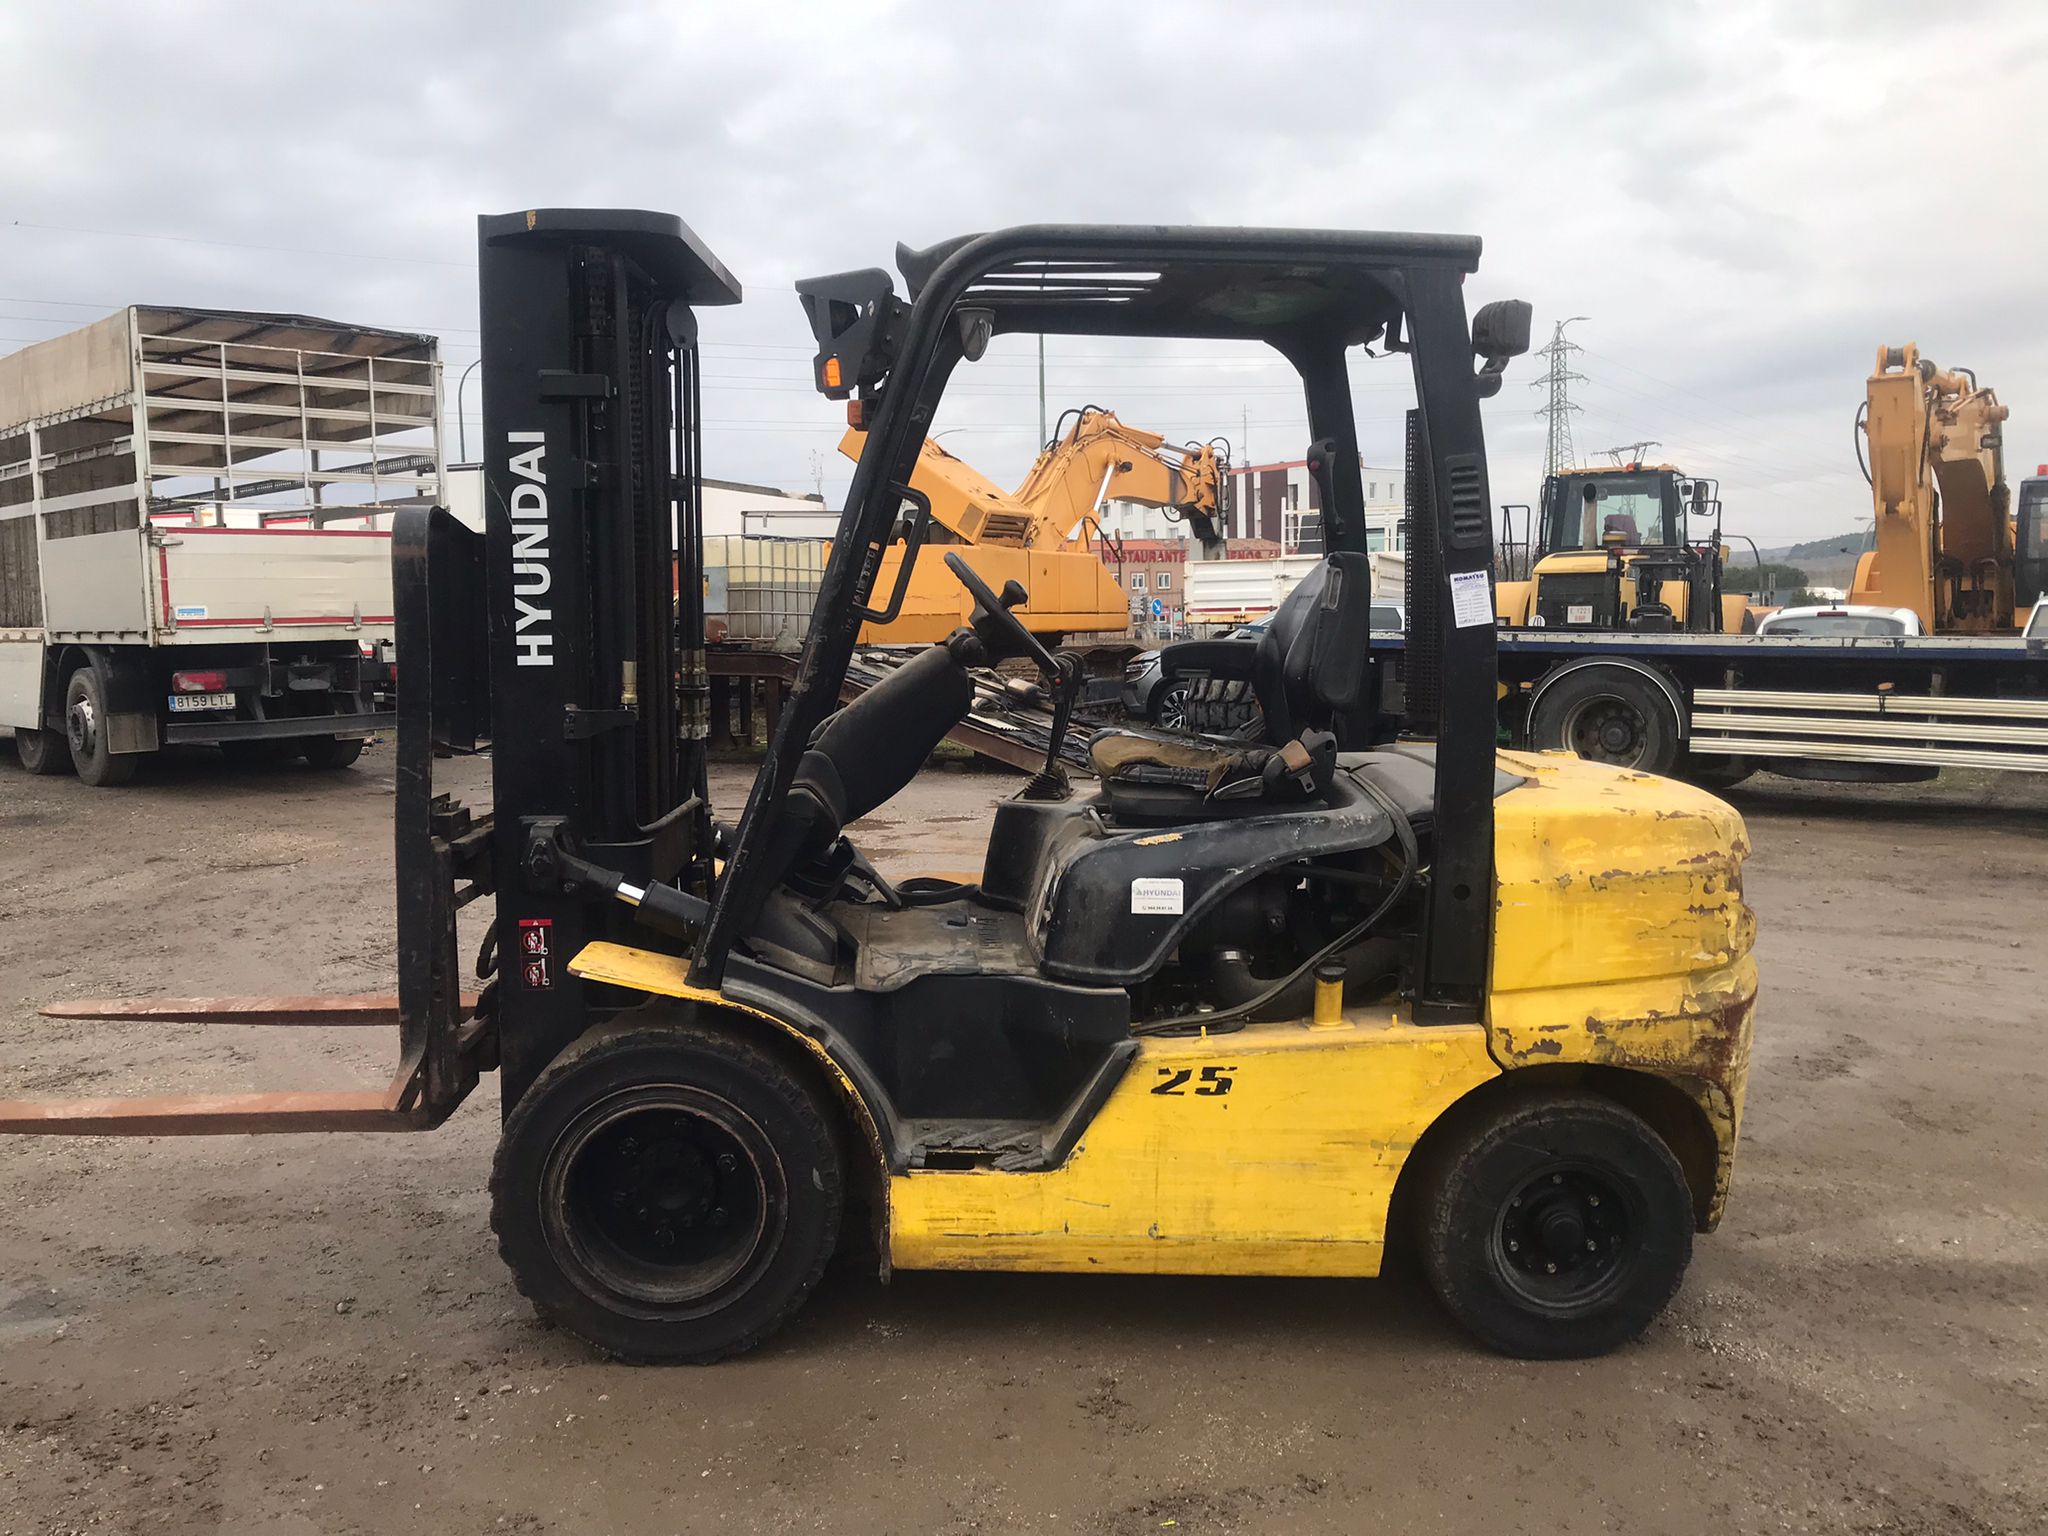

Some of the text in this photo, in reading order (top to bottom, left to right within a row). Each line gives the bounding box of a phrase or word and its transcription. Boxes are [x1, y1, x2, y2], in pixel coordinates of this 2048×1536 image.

[508, 432, 554, 665] HYUNDAI
[1104, 550, 1186, 563] RESTAURANTE
[1454, 573, 1485, 582] KOMATSU
[177, 695, 233, 708] 8159 LTL
[1151, 1066, 1238, 1096] 25
